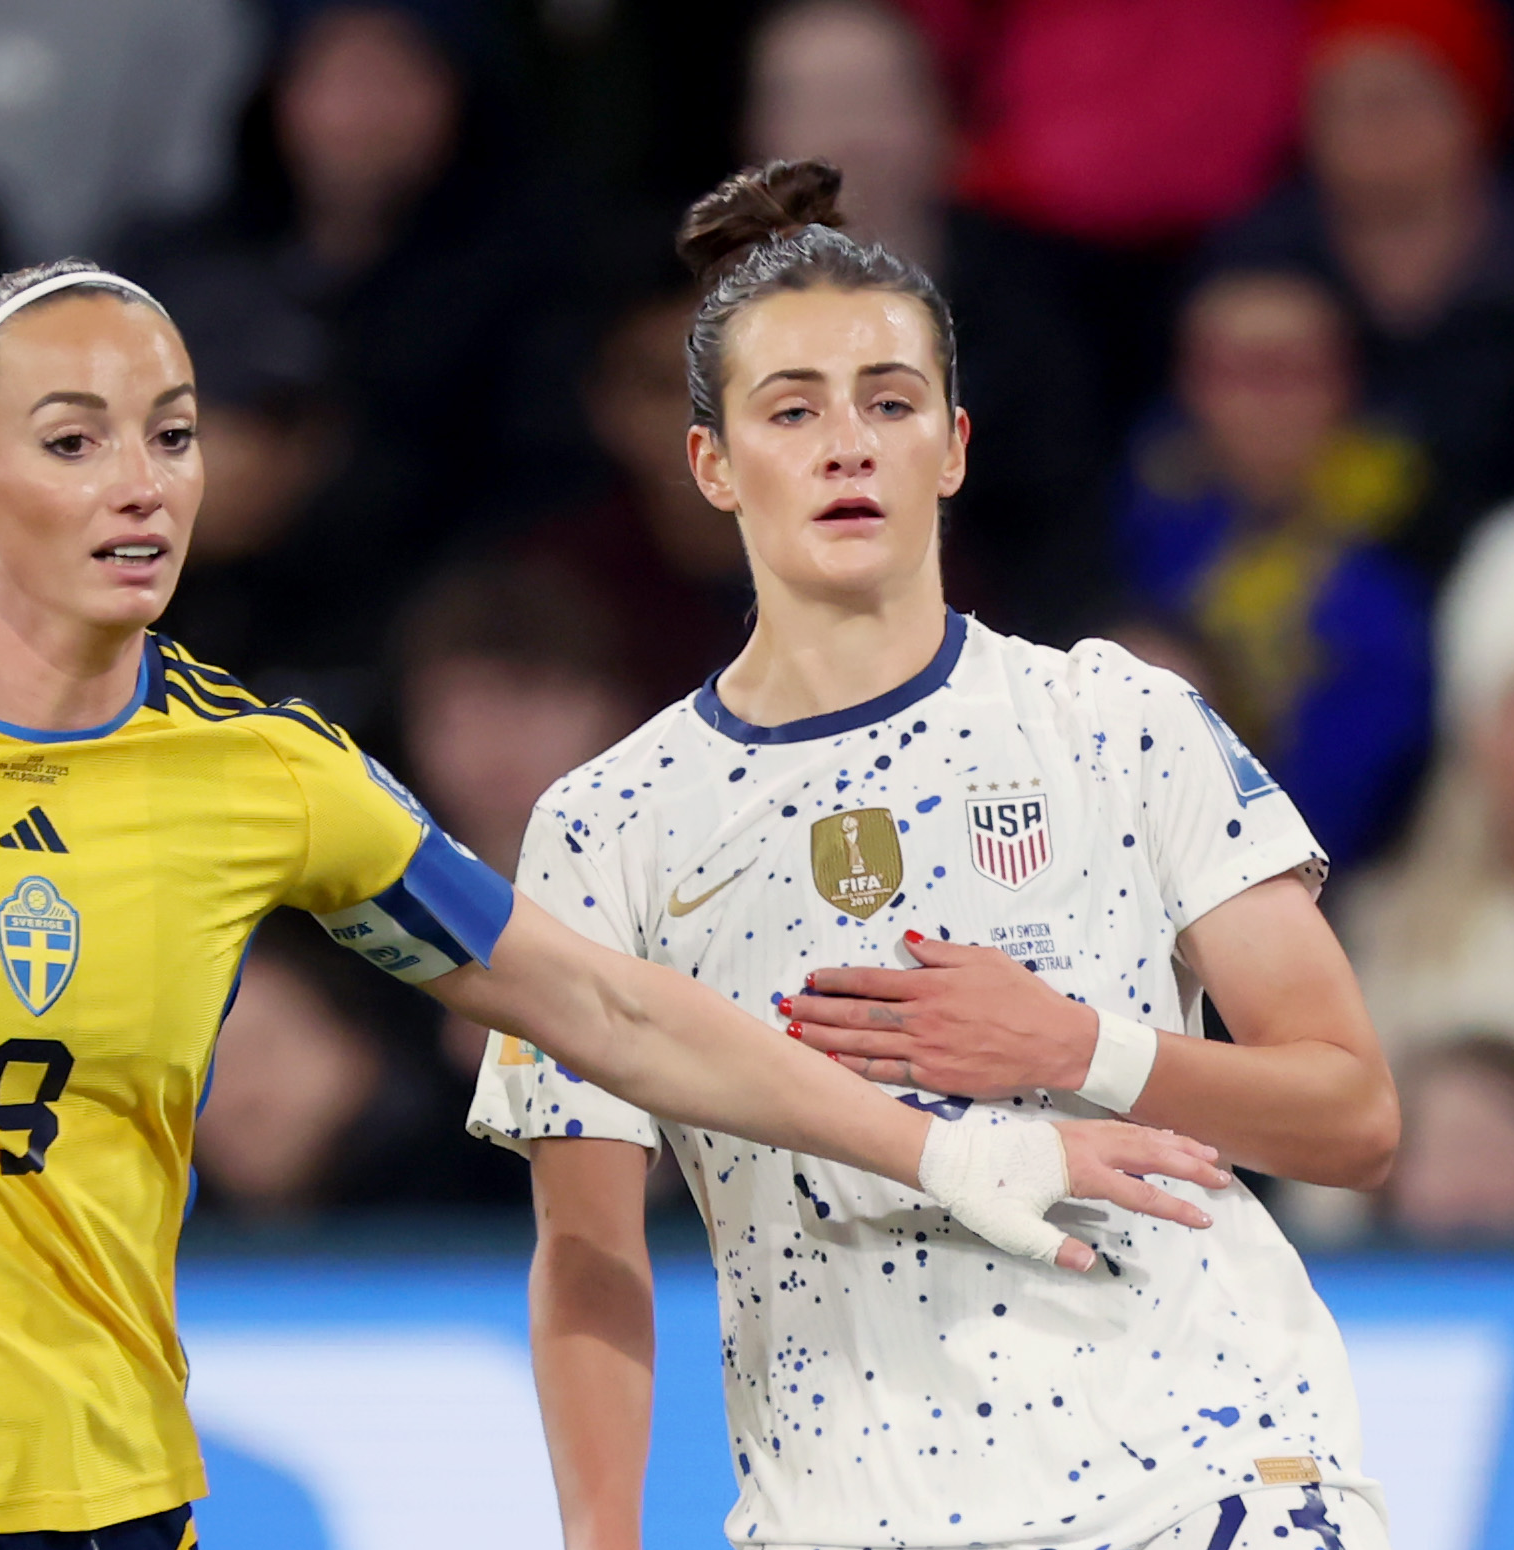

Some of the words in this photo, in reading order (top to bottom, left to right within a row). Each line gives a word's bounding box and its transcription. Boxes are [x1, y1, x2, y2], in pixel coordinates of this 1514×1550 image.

[973, 802, 1042, 837] USA
[839, 875, 881, 895] FIFA
[11, 917, 64, 930] SVERIGE
[331, 922, 373, 940] FIFA
[990, 927, 1007, 942] USA
[1017, 923, 1052, 939] SWEDEN
[1034, 940, 1056, 954] 2023
[1031, 955, 1073, 971] USTRALIA
